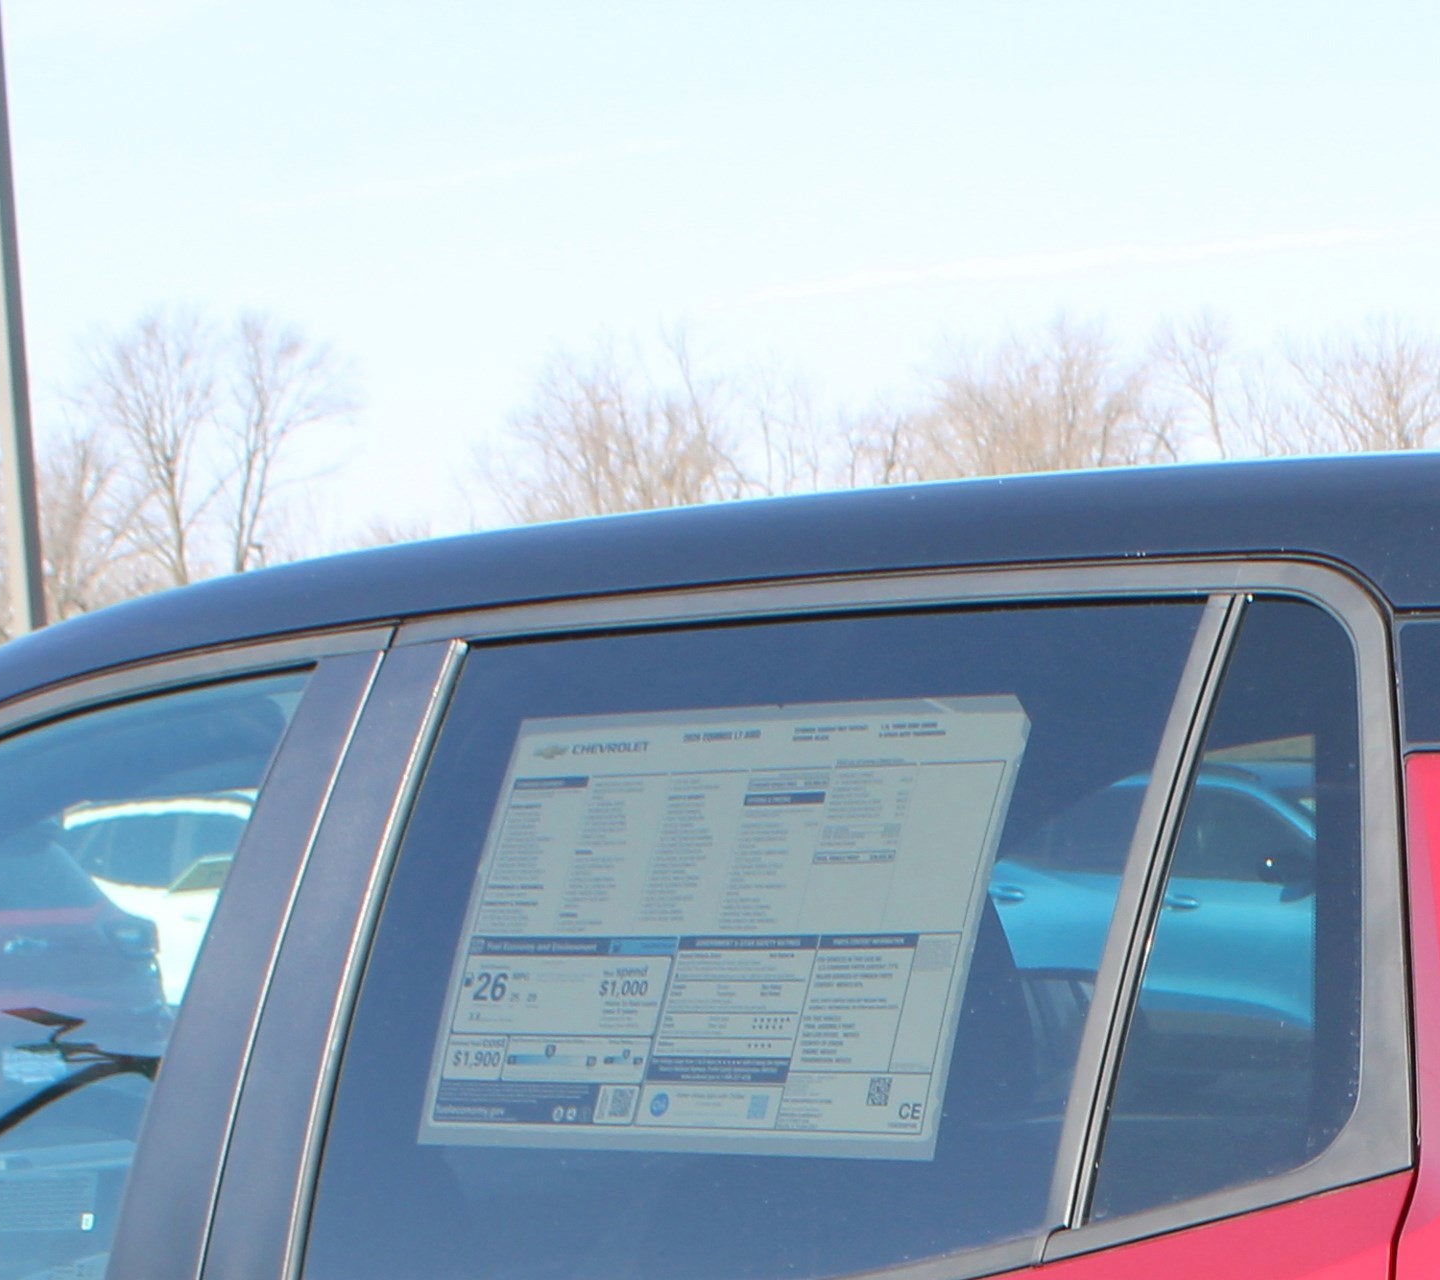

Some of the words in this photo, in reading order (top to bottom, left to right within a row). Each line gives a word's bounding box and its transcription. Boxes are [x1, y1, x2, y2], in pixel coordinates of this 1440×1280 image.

[572, 740, 651, 756] CHEVROLET
[472, 971, 509, 1002] 26
[598, 979, 649, 998] $1,000
[452, 1051, 502, 1069] $1,900
[898, 1103, 923, 1120] CE
